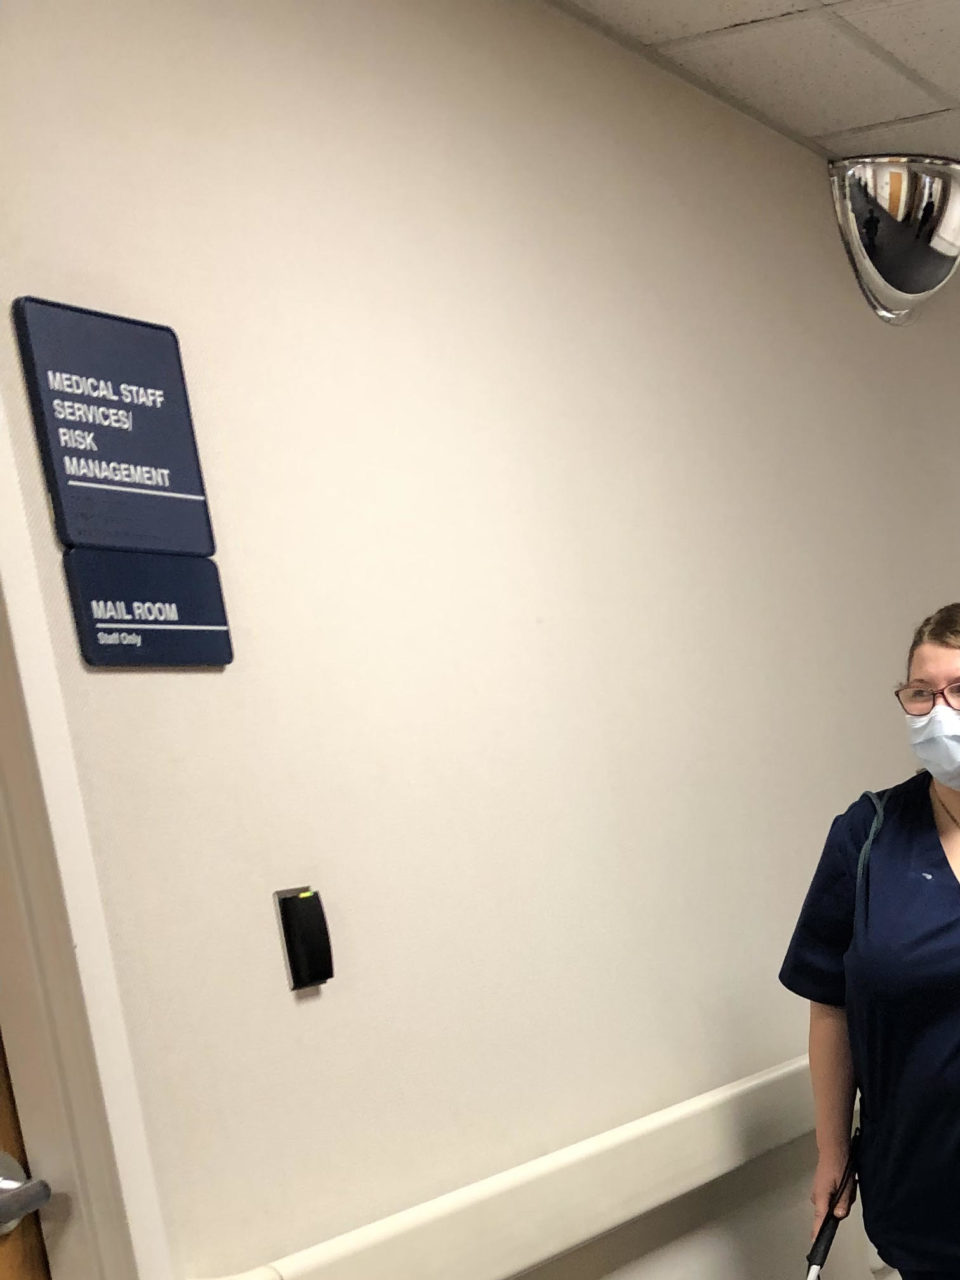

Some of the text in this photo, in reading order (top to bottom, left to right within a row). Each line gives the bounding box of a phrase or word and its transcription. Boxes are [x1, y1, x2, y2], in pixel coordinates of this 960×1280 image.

[47, 370, 165, 408] MEDICAL STAFF
[58, 427, 98, 451] RISK
[63, 455, 170, 487] MANAGEMENT
[91, 600, 179, 621] MAIL ROOM
